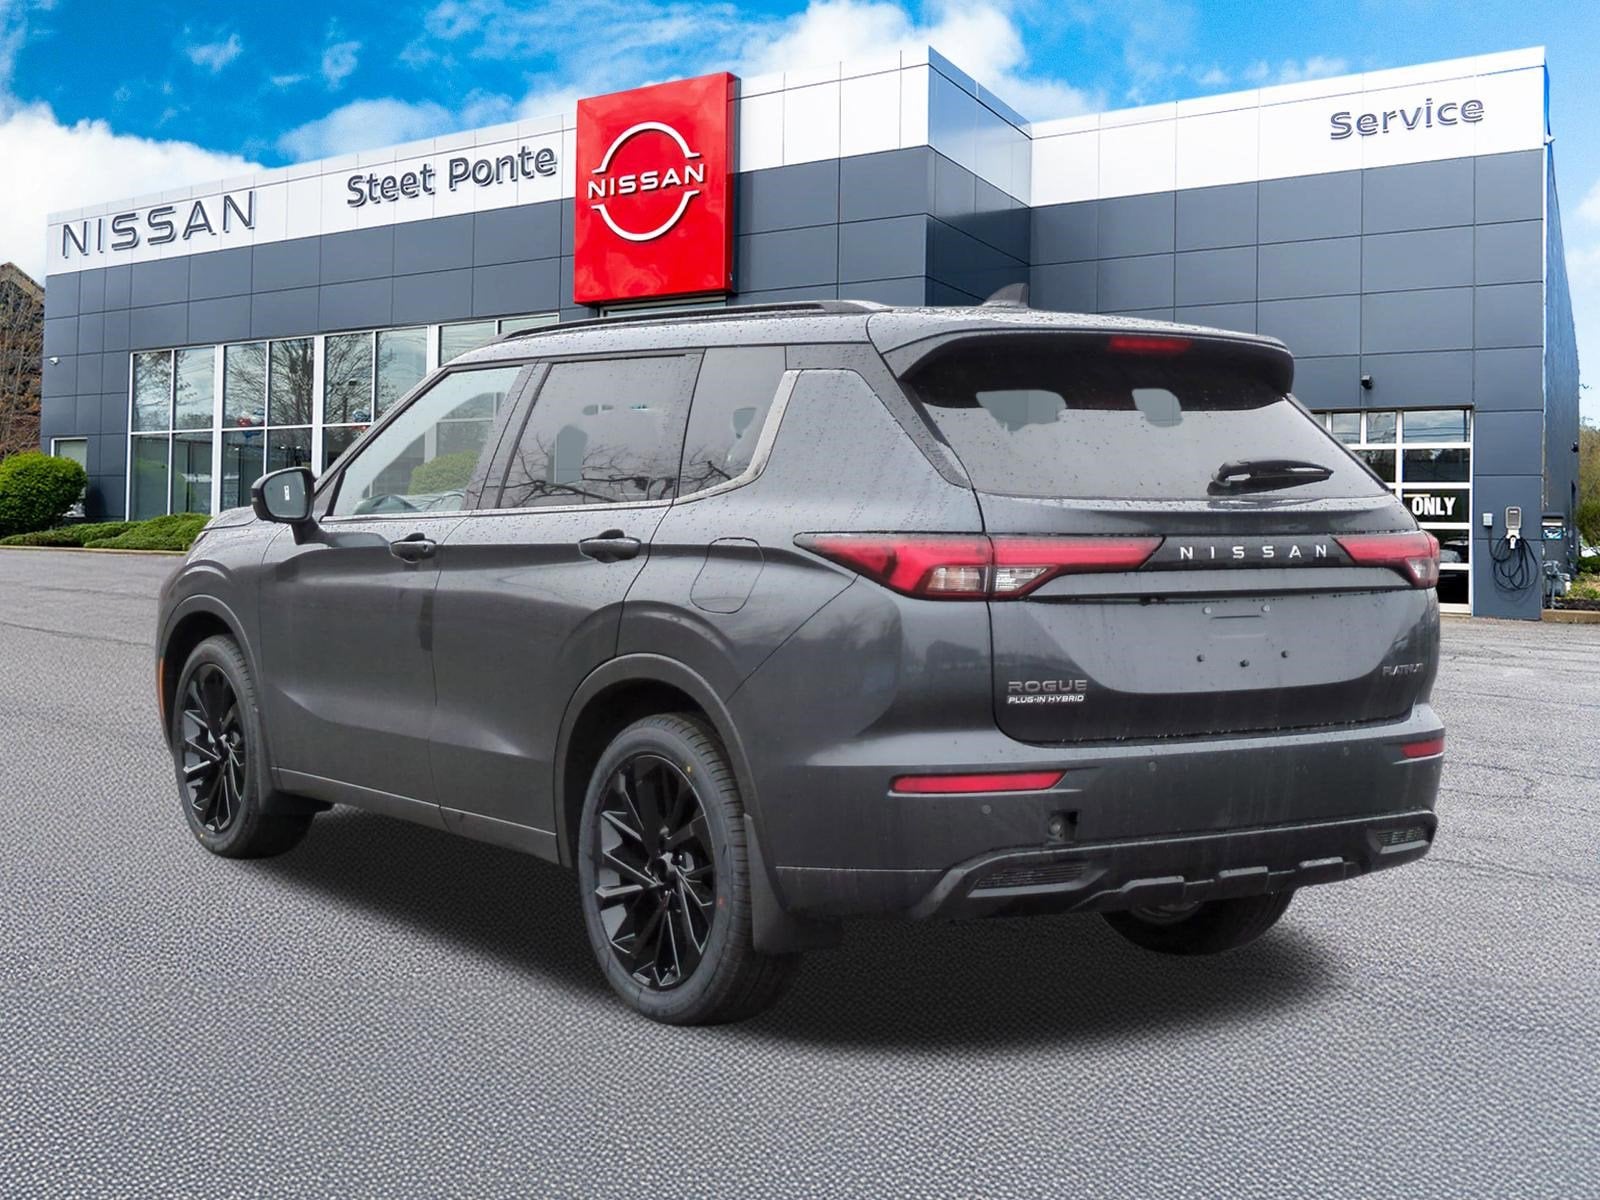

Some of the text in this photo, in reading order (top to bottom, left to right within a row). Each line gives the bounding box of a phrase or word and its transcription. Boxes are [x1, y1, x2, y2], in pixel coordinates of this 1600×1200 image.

[1330, 97, 1485, 140] Service
[347, 145, 557, 207] Steet Ponte
[587, 162, 705, 201] NISSAN
[62, 190, 256, 259] NISSAN
[1411, 496, 1457, 516] ONLY
[1179, 544, 1327, 560] NISSAN
[1007, 694, 1085, 704] PLUG-IN HYBRID
[1008, 679, 1088, 693] ROGUE
